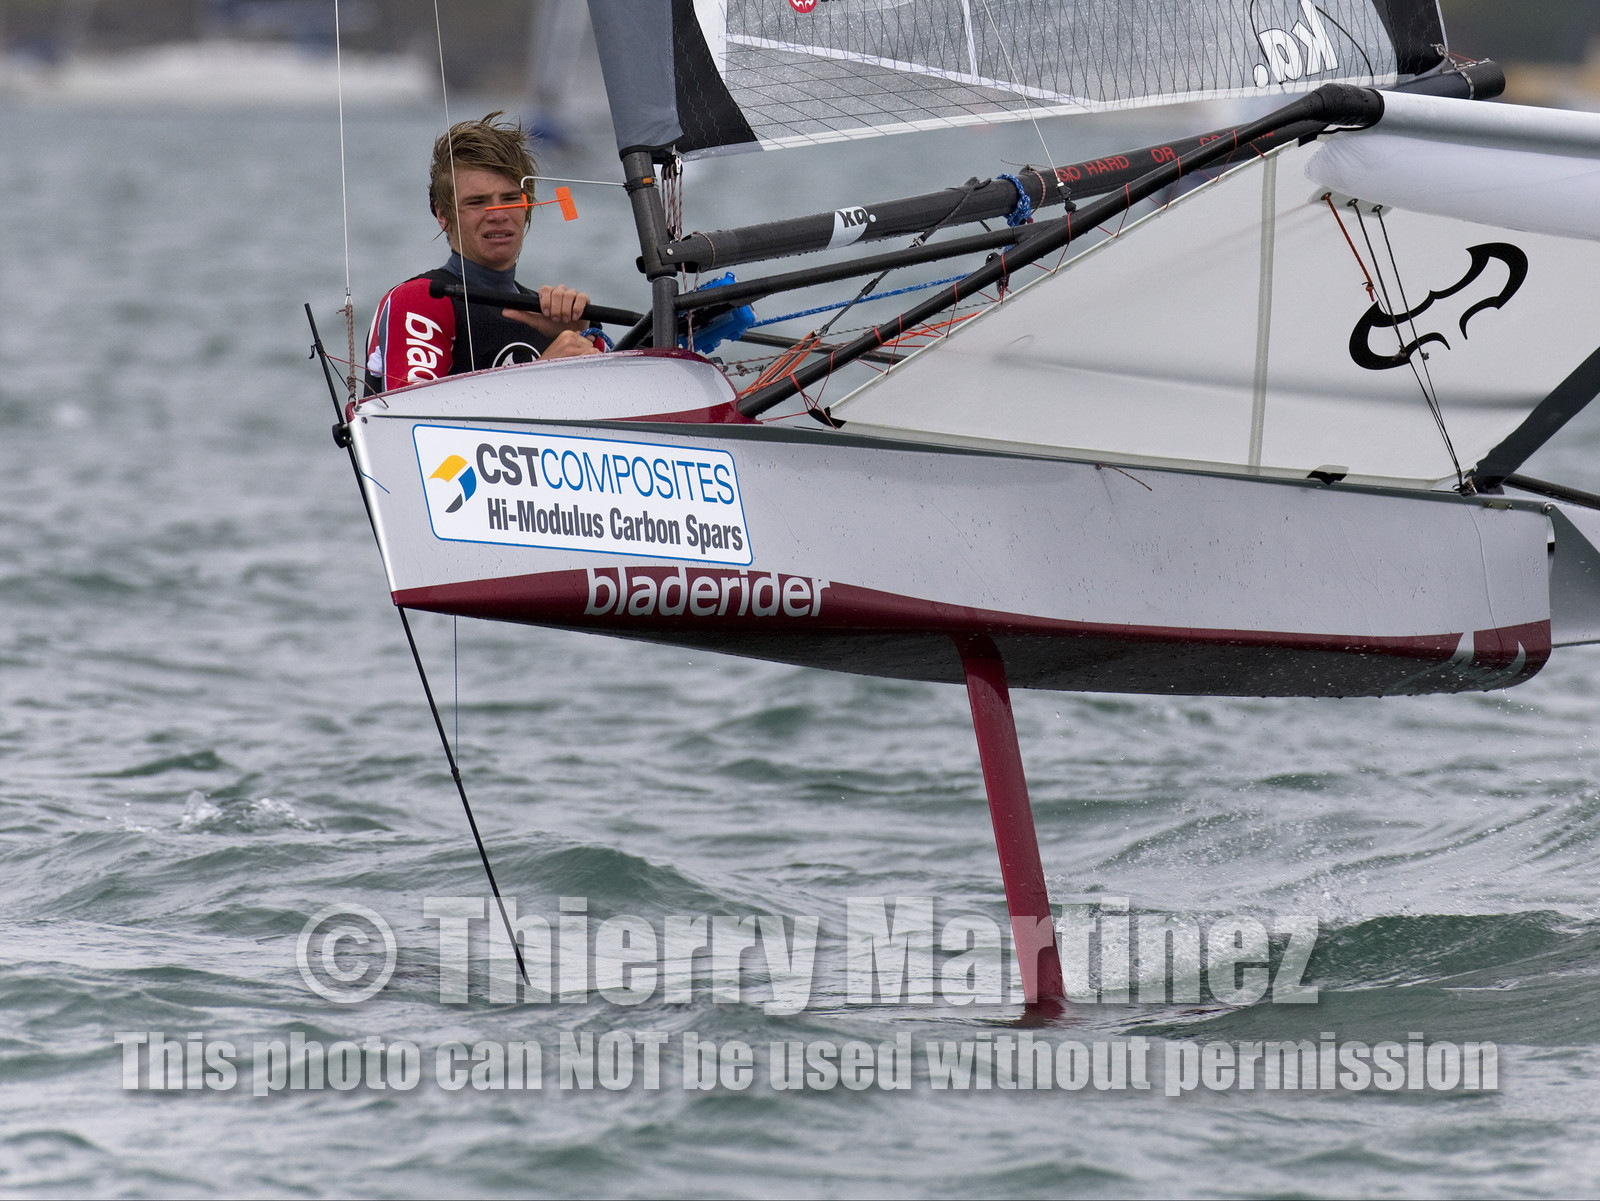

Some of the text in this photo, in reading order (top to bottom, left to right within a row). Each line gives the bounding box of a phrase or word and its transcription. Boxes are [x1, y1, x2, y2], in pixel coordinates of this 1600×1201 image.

[1057, 166, 1081, 183] GO
[1084, 155, 1130, 176] HARD
[1151, 146, 1176, 164] OR
[487, 498, 743, 554] Hi-Modulus Carbon Spars
[584, 567, 831, 617] bladerider
